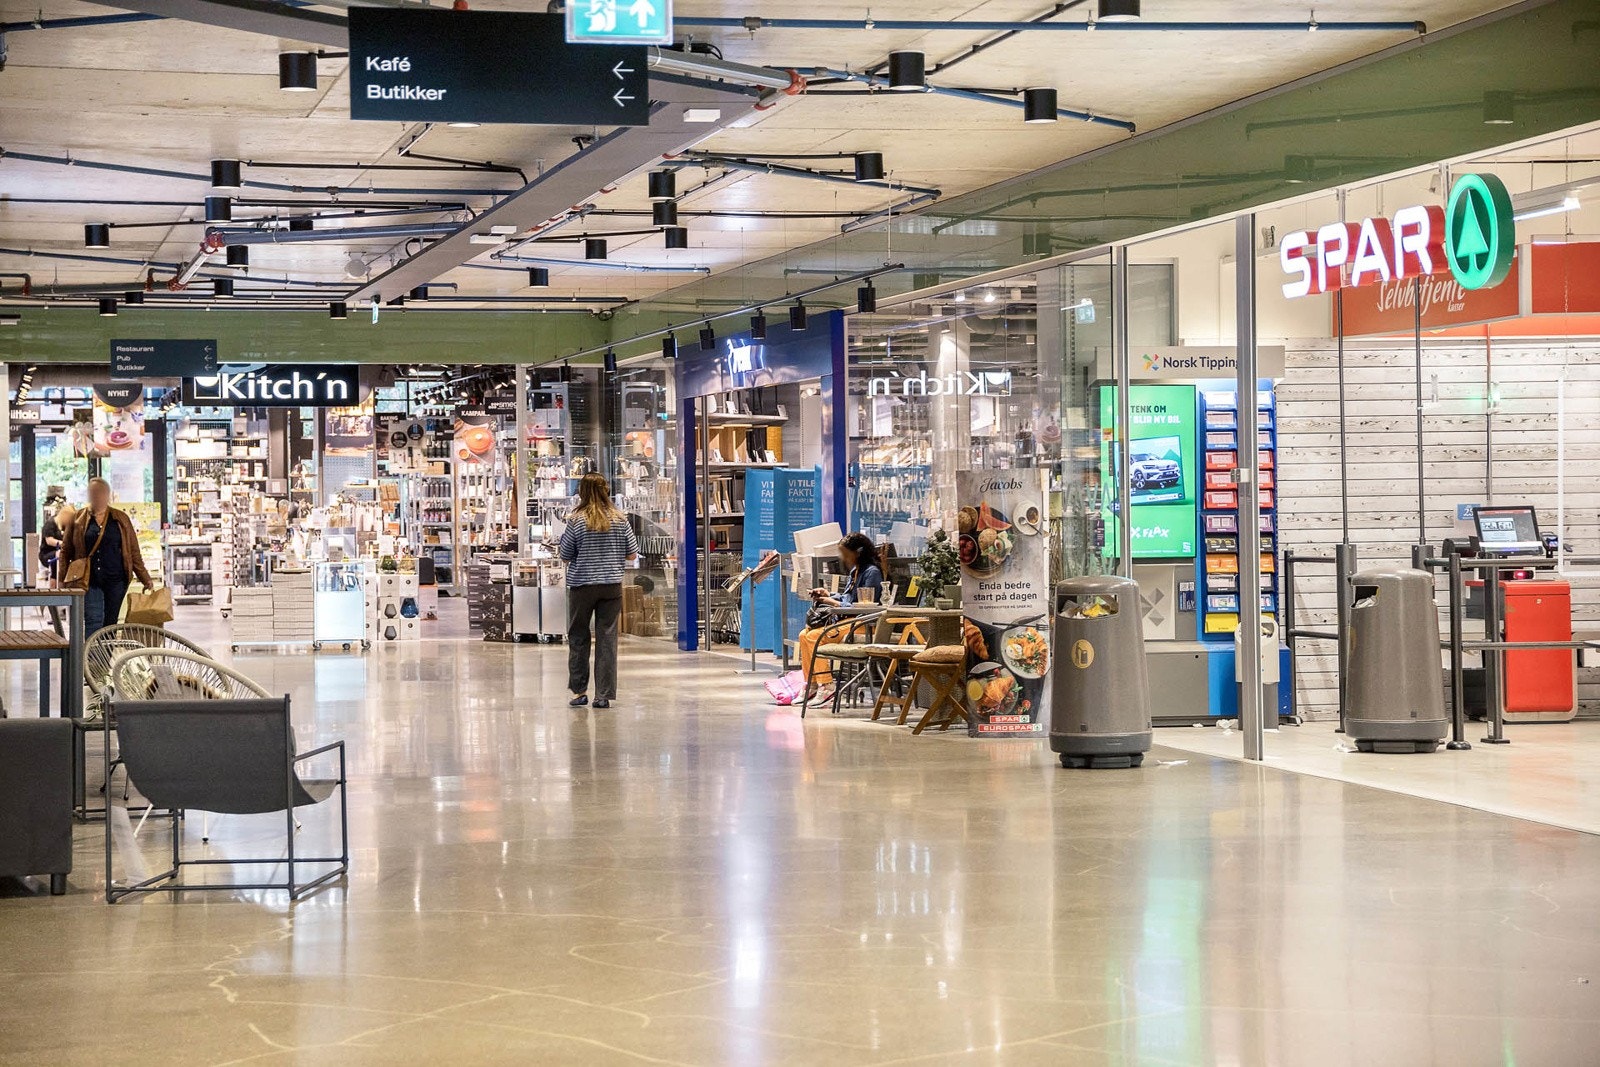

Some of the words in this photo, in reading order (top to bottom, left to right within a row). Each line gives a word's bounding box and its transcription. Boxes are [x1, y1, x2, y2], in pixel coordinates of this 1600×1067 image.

[366, 56, 411, 72] Kafé
[366, 84, 447, 101] Butikker
[1280, 204, 1434, 299] SPAR
[1163, 356, 1198, 369] Norsk
[1198, 356, 1238, 370] Tippin
[107, 389, 130, 397] NYHET
[1130, 405, 1152, 414] TENK
[1153, 405, 1167, 413] OM
[979, 477, 1023, 494] Jacobs
[979, 582, 1002, 590] Enda
[1004, 581, 1031, 590] bedre
[995, 592, 1007, 602] på
[1009, 592, 1038, 602] dagen
